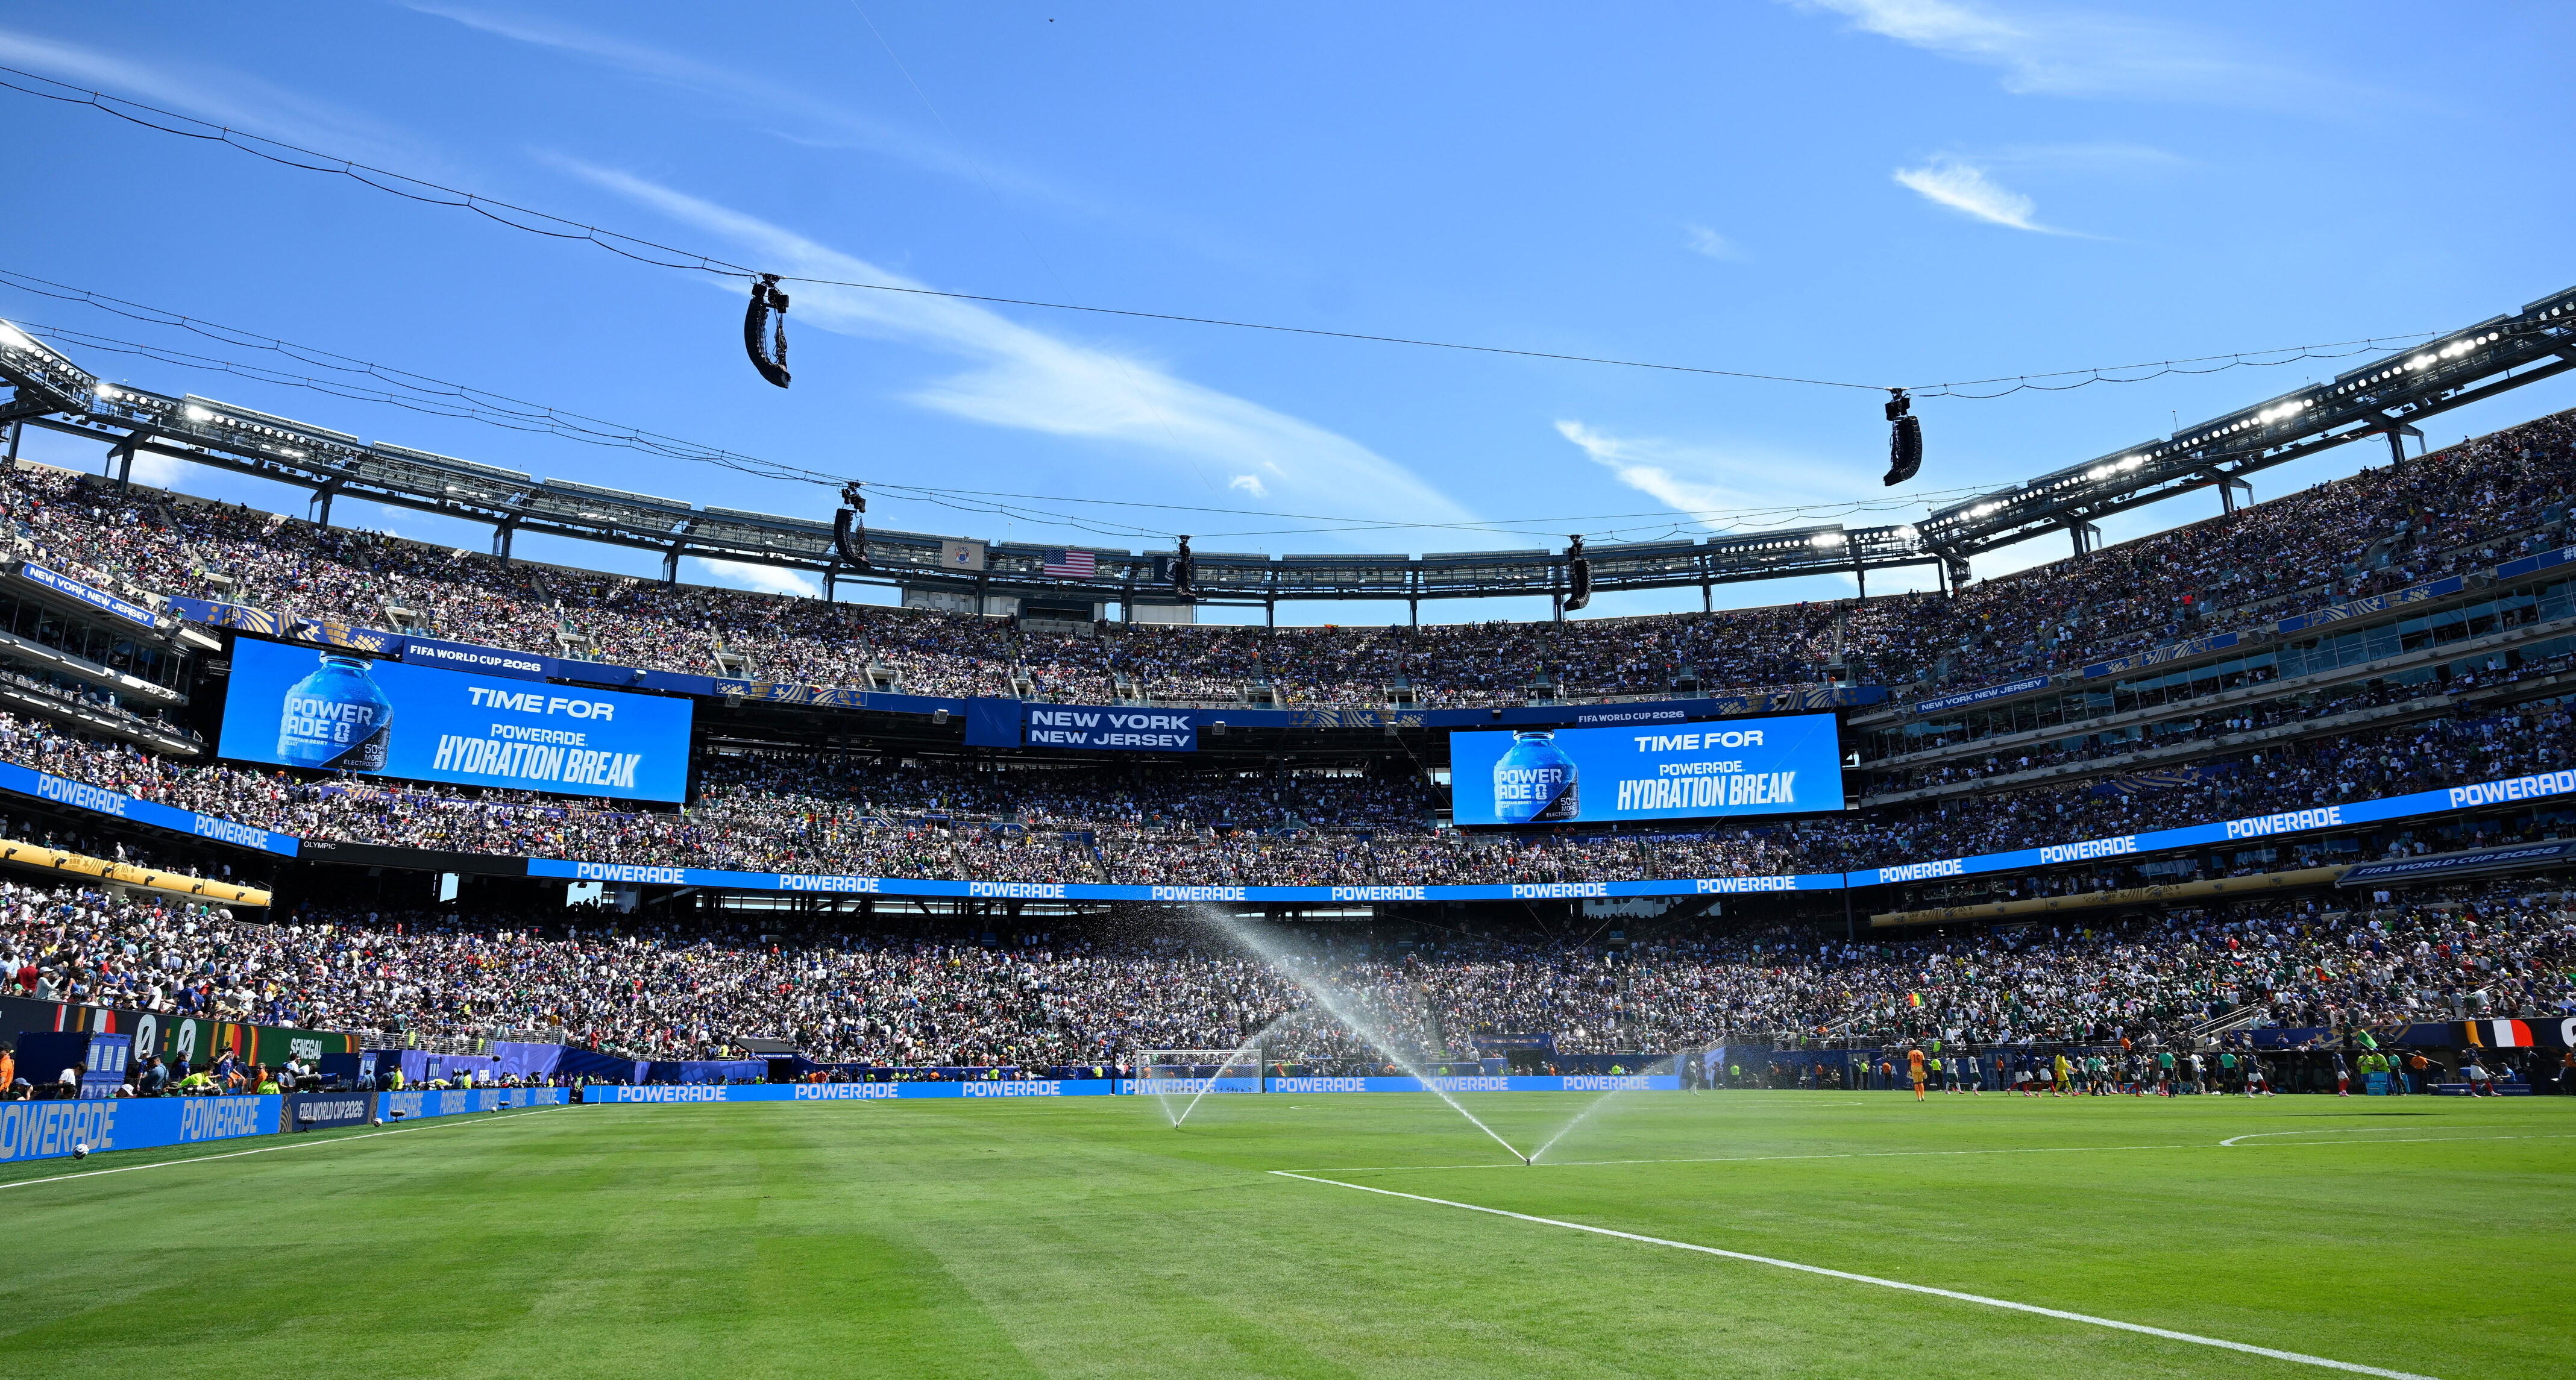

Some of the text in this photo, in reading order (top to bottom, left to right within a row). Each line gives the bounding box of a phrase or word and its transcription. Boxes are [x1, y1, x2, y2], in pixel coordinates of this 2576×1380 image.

[30, 567, 150, 621] NEW YORK NEW JERSEY
[410, 645, 542, 672] FIFA WORLD CUP 2026
[468, 687, 615, 721] TIME FOR
[1921, 679, 2042, 710] NEW YORK NEW JERSEY
[291, 698, 373, 726] POWER
[1032, 710, 1190, 730] NEW YORK
[1599, 714, 1632, 722] WORLD
[1652, 710, 1685, 719] 2026
[287, 716, 331, 739] ADE
[491, 724, 585, 747] POWERADE
[1031, 730, 1190, 747] NEW JERSEY
[1634, 730, 1764, 752] TIME FOR
[433, 735, 641, 788] HYDRATION BREAK
[1659, 761, 1742, 776] POWERADE
[1499, 768, 1562, 785] POWER
[37, 774, 127, 816] POWERADE
[1500, 784, 1531, 799] ADE
[1617, 771, 1795, 811] HYDRATION BREAK
[2449, 771, 2576, 808] POWERAD
[194, 815, 269, 849] POWERADE
[2226, 806, 2342, 838] POWERADE
[303, 841, 336, 850] OLYMPIC
[2040, 835, 2137, 864] POWERADE
[1879, 859, 1962, 883] POWERADE
[2358, 847, 2562, 875] FIFA WORLD CUP 2026
[577, 862, 684, 884] POWERADE
[779, 874, 879, 892] POWERADE
[970, 882, 1064, 899] POWERADE
[1152, 886, 1245, 900] POWERADE
[1332, 886, 1425, 900] POWERADE
[1512, 883, 1607, 899] POWERADE
[1697, 876, 1795, 893] POWERADE
[134, 1014, 157, 1063] 0
[177, 1018, 196, 1063] 0
[291, 1038, 322, 1059] SENEGAL
[1914, 1055, 1920, 1063] 16
[480, 1069, 489, 1082] FIFA
[1879, 1065, 1898, 1075] FA
[618, 1085, 727, 1102] POWERADE
[796, 1083, 898, 1100] POWERADE
[963, 1081, 1060, 1096] POWERADE
[1276, 1077, 1365, 1092] POWERADE
[1563, 1076, 1650, 1090] POWERADE
[180, 1098, 260, 1141] POWERADE
[299, 1100, 363, 1121] FIFA WORLD CUP 2026
[0, 1102, 118, 1159] OWERADE
